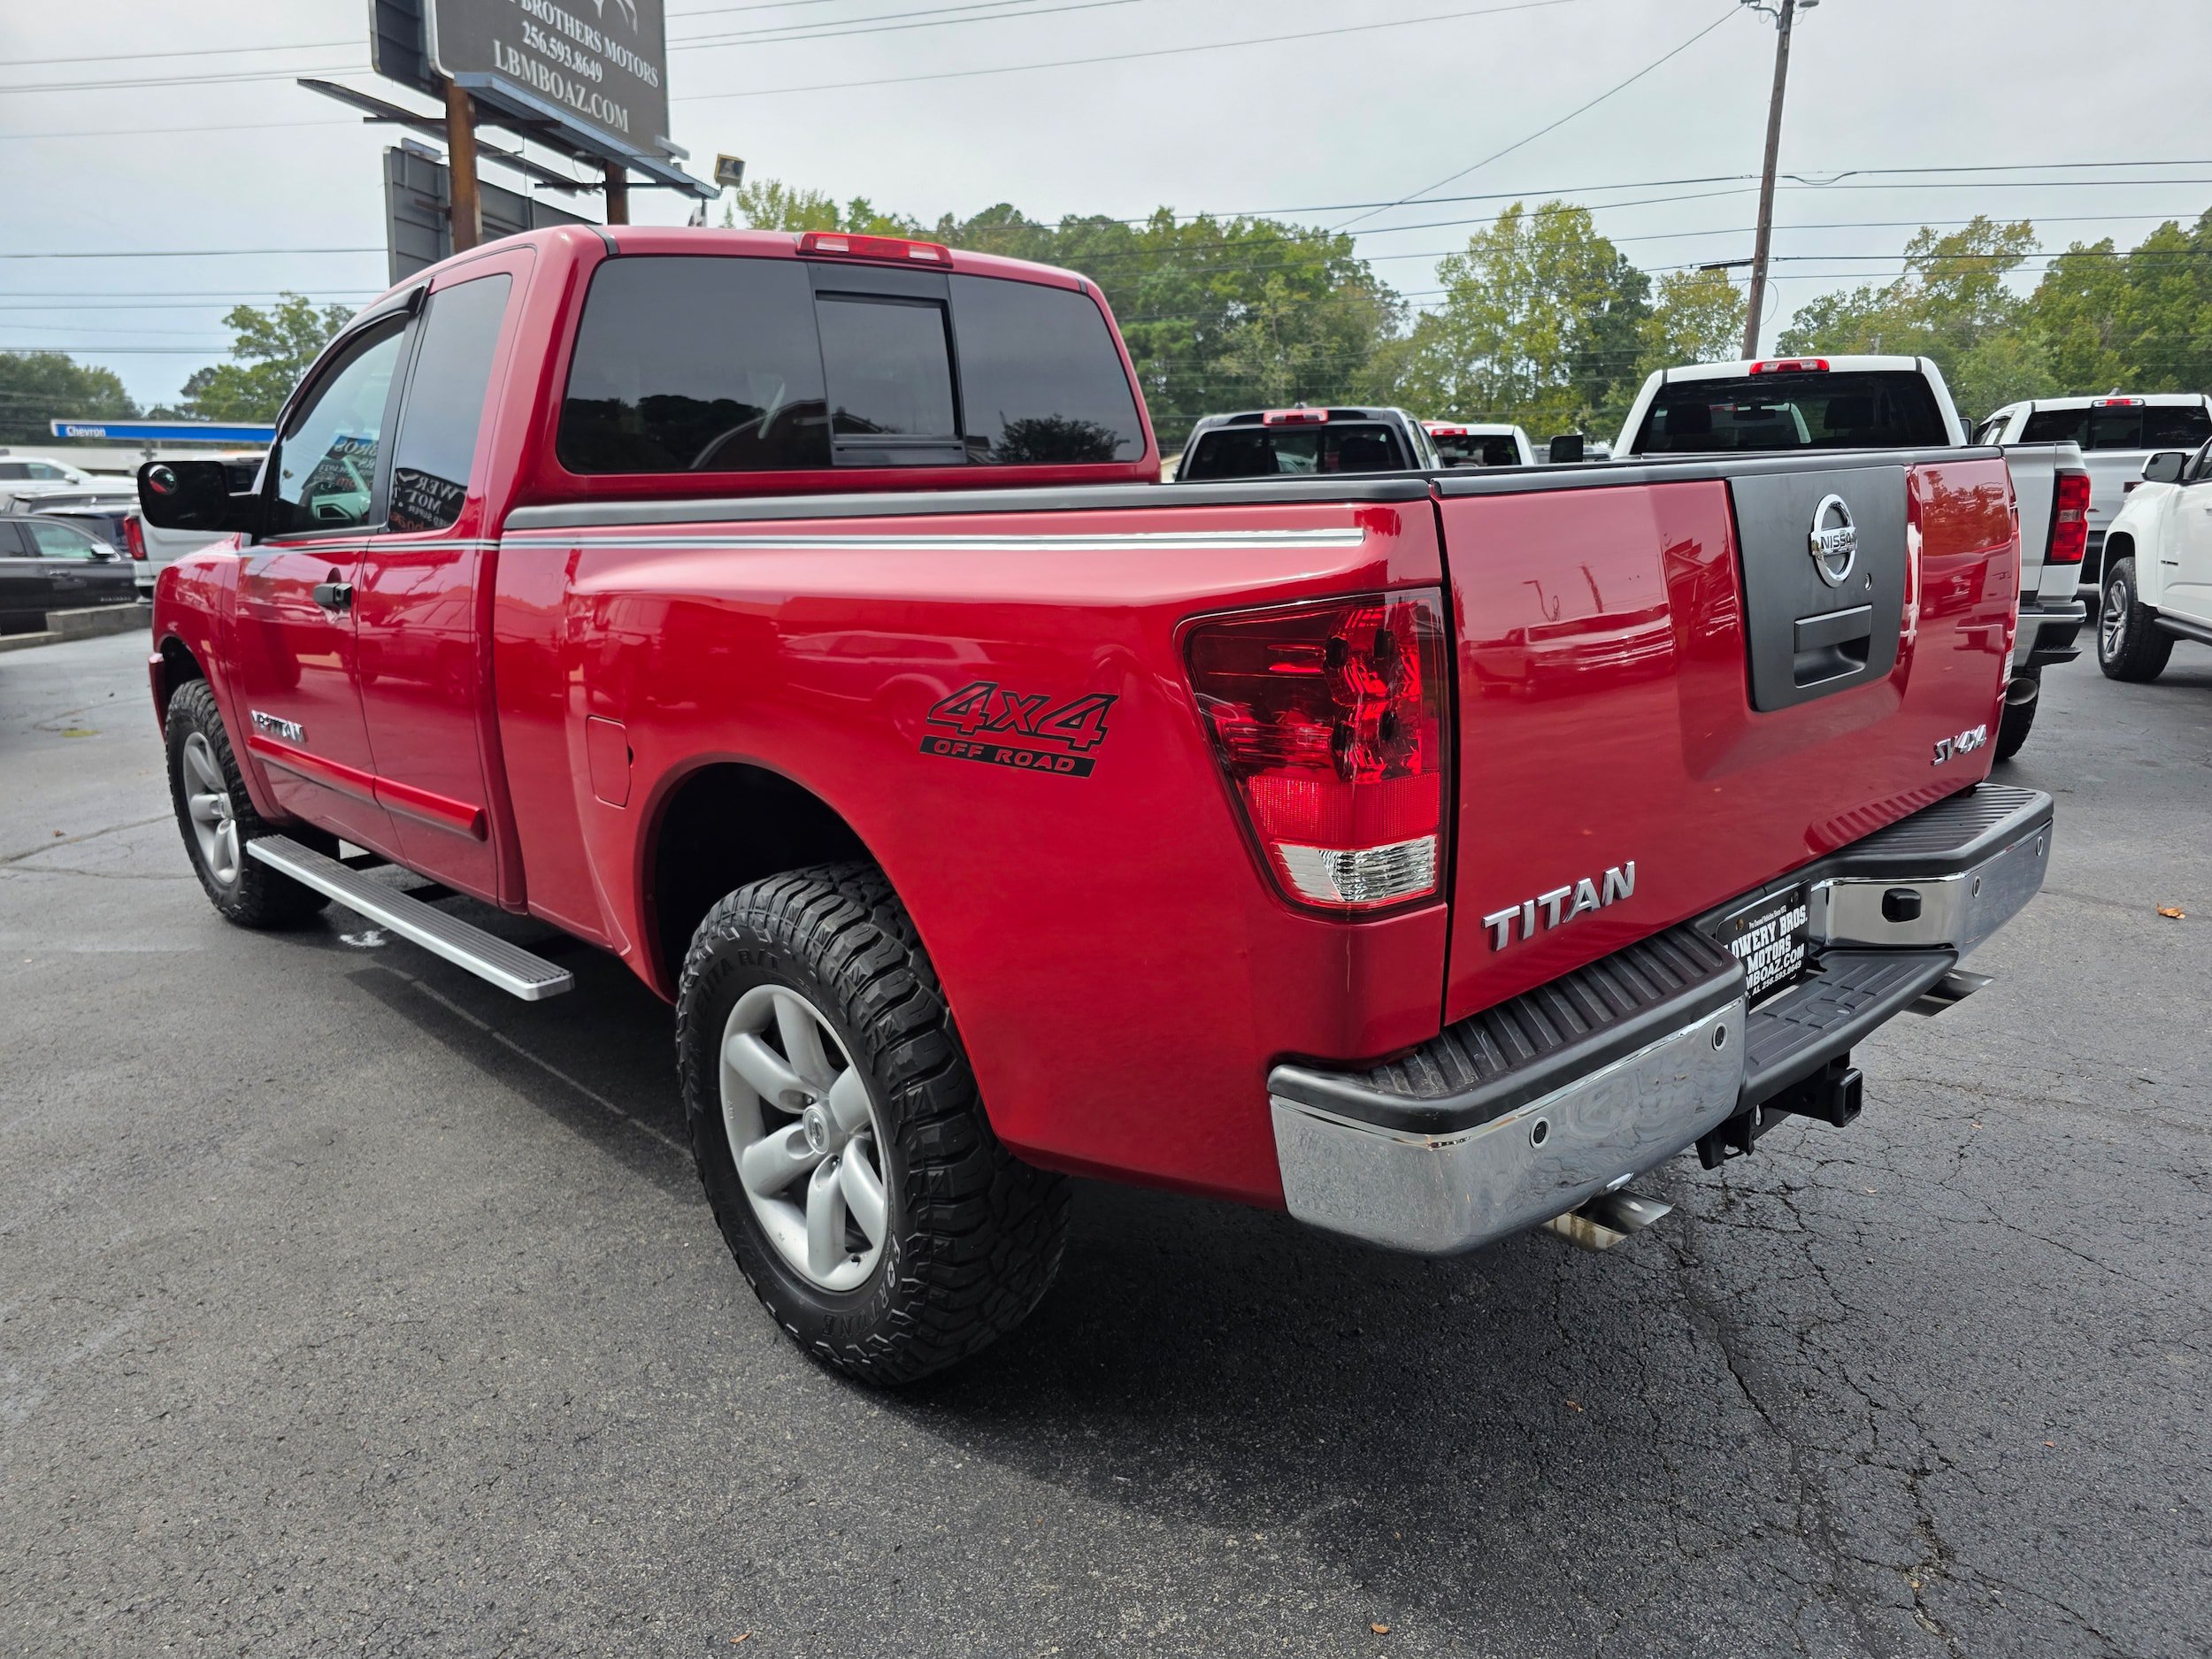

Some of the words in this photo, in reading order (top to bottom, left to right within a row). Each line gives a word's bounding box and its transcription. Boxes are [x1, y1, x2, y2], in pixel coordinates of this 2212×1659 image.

[521, 0, 603, 53] BROTHERS
[603, 36, 659, 88] MOTORS
[521, 19, 603, 83] 256.593.8649
[493, 39, 630, 133] LBMBOAZ.COM
[65, 426, 107, 438] Chevron
[933, 740, 984, 757] OFF
[995, 749, 1076, 772] ROAD
[1931, 735, 1958, 766] SV
[1482, 860, 1636, 953] TITAN
[1724, 920, 1777, 960] OWERY
[1747, 933, 1792, 975] MOTORS
